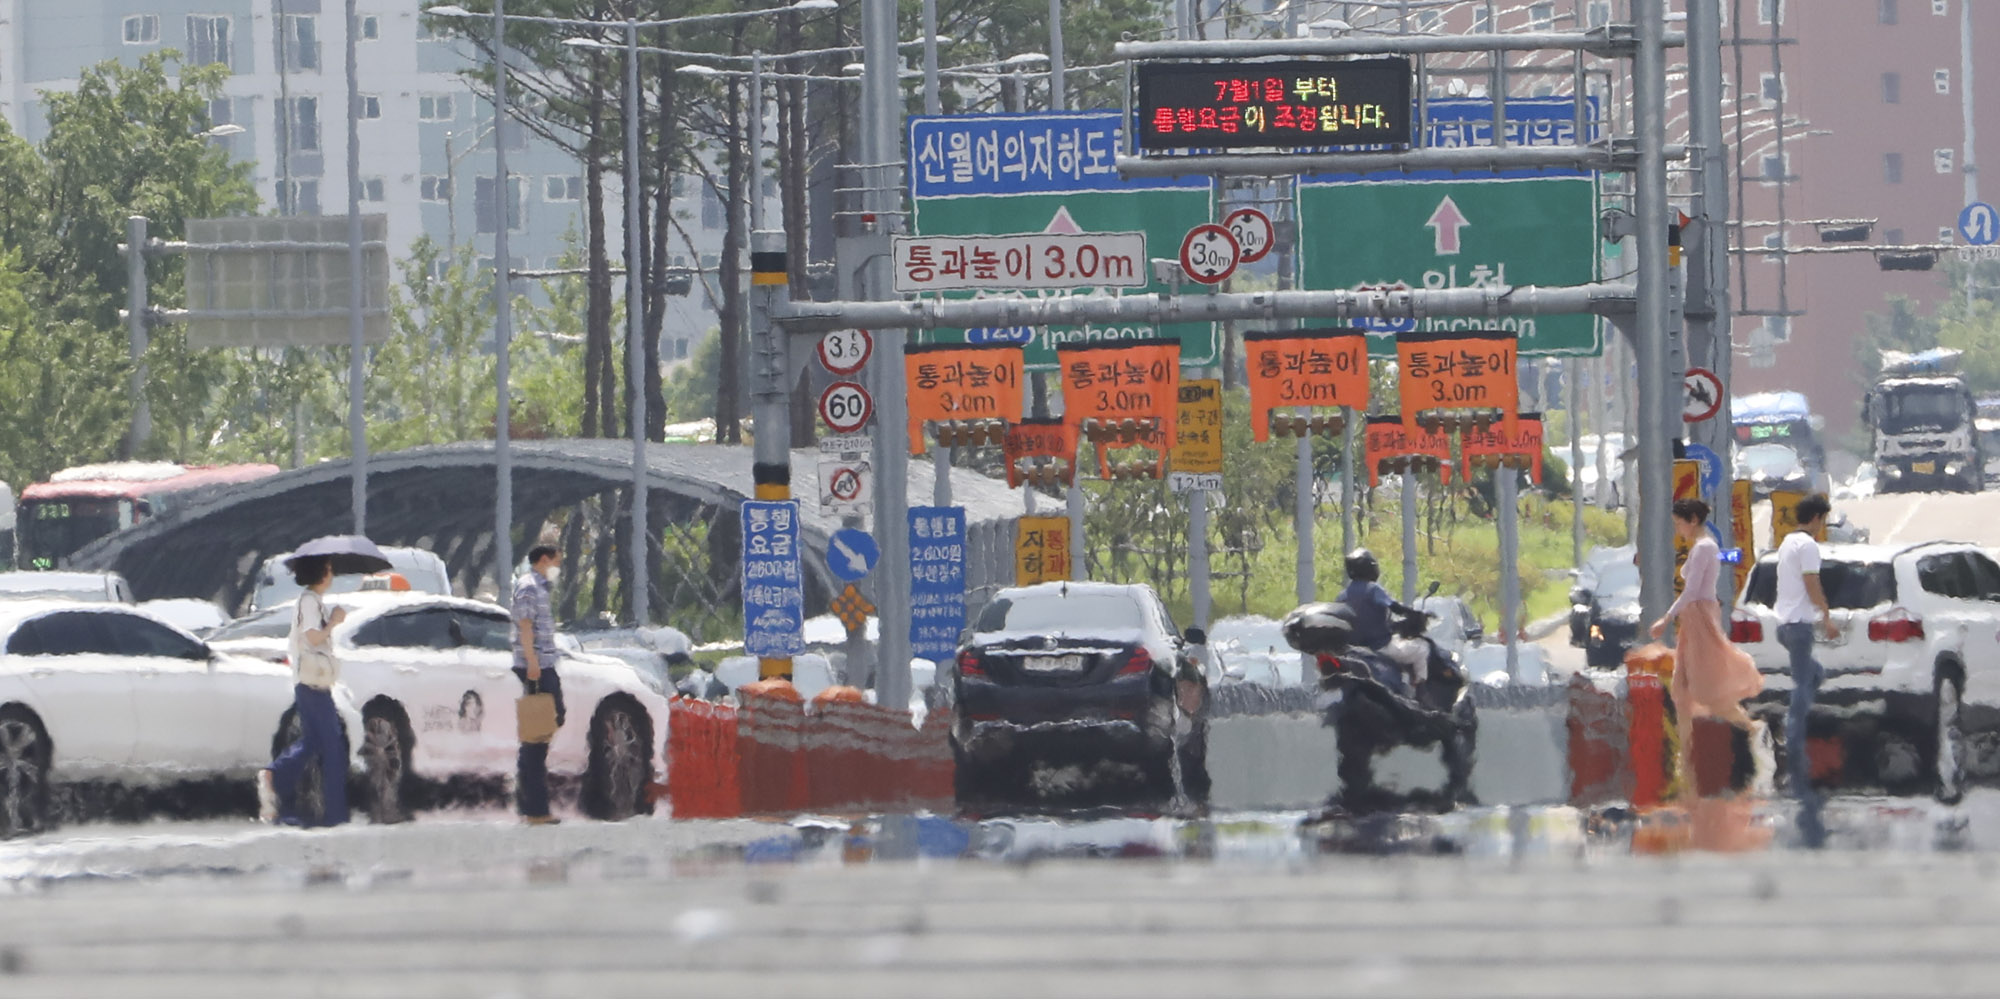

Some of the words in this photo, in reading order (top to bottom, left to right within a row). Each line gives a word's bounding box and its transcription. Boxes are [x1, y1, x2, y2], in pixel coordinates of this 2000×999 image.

[1214, 78, 1284, 102] 7월1일
[1293, 77, 1336, 101] 부터
[1153, 106, 1265, 133] 통행요금이
[1273, 104, 1390, 132] 조정됩니다.
[905, 245, 1032, 282] 통과높이
[1044, 244, 1134, 279] 3.0m
[1192, 243, 1230, 266] 3.0m
[915, 361, 1015, 389] 통과높이
[1069, 357, 1171, 389] 통과높이
[1259, 348, 1358, 378] 통과높이
[1408, 349, 1509, 378] 통과높이
[1096, 391, 1150, 412] 3.0m
[1280, 379, 1336, 400] 3.0m
[1431, 380, 1487, 402] 3.0m
[829, 393, 862, 419] 60
[939, 392, 996, 413] 3.0m
[749, 508, 791, 533] 통행
[749, 533, 792, 556] 요금
